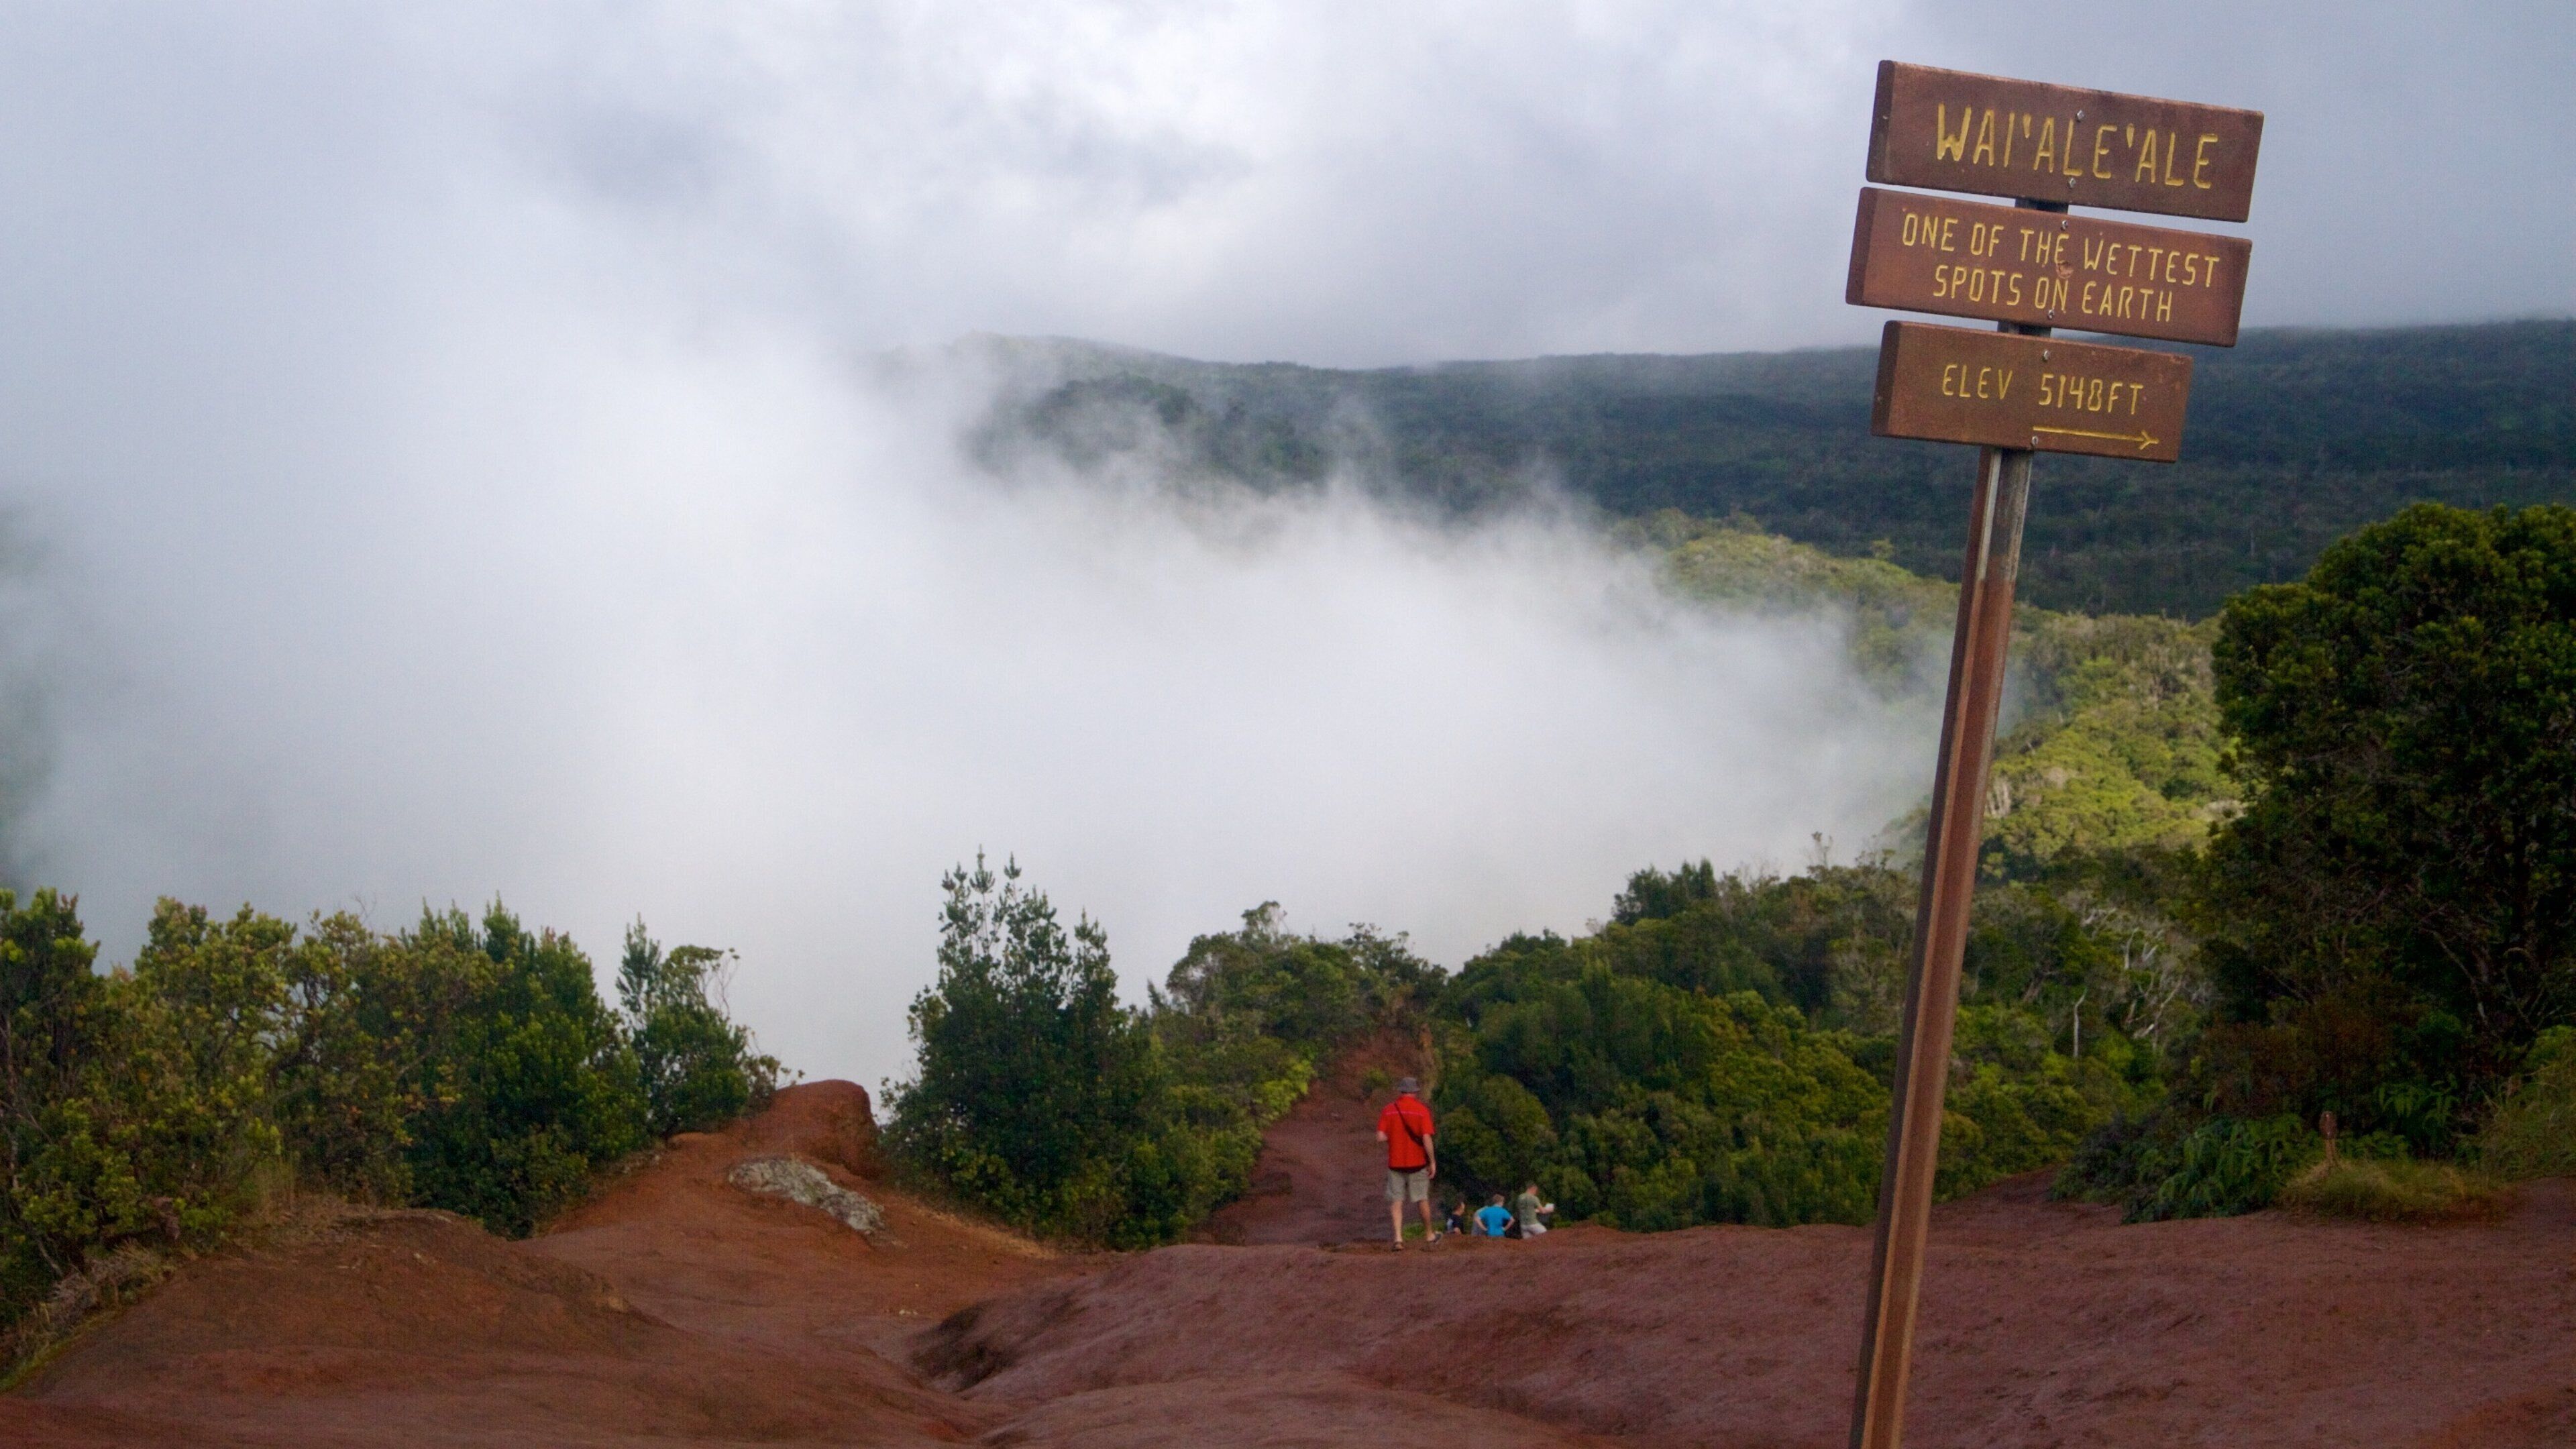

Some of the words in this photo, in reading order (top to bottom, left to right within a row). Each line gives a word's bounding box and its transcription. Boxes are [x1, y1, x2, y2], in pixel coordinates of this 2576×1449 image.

[1937, 102, 2218, 189] WAI'ALE'ALE
[1902, 212, 1958, 252] ONE
[1970, 222, 2004, 257] OF
[2019, 228, 2070, 264] THE
[2084, 236, 2220, 288] WETTEST
[1933, 265, 2023, 306] SPOTS
[2034, 277, 2069, 313] ON
[2081, 280, 2173, 323] EARTH
[1941, 364, 2014, 400] ELEV
